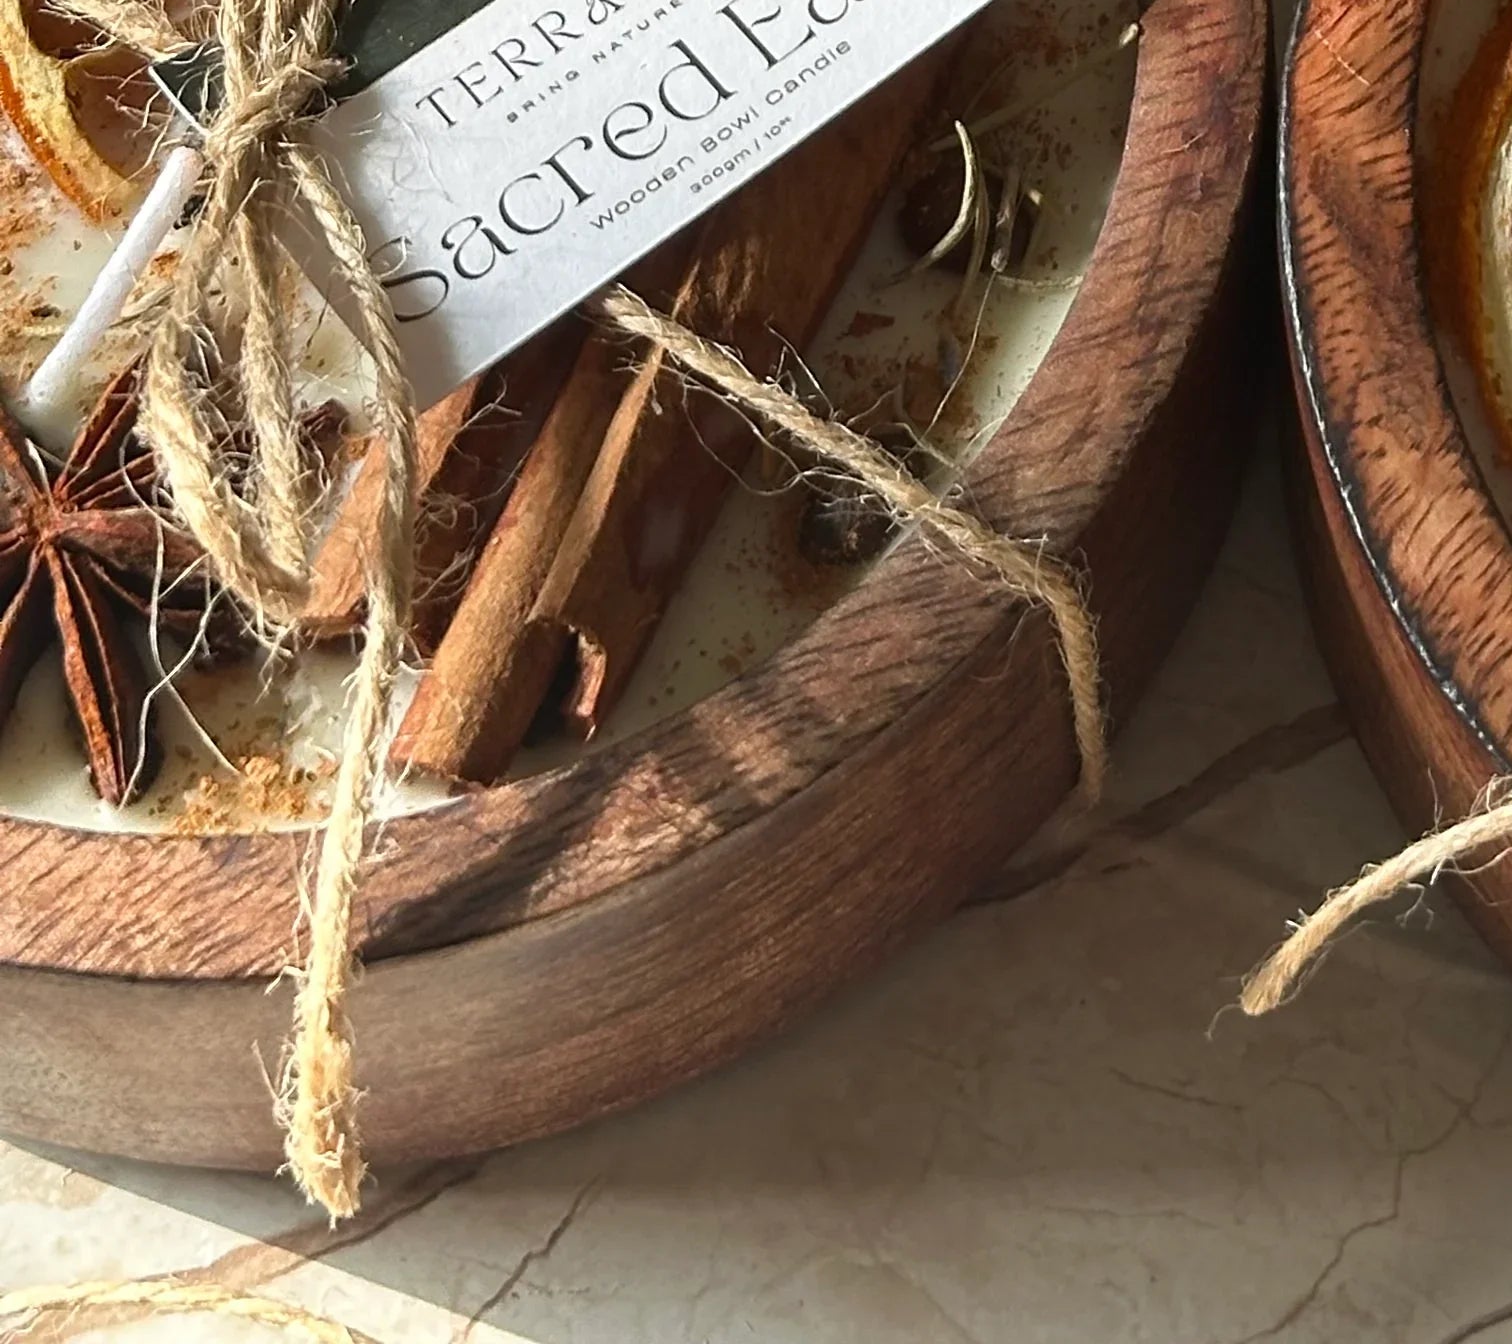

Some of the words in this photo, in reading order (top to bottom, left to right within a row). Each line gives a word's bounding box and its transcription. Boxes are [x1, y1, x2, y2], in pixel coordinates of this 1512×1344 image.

[367, 39, 739, 323] Sacred
[506, 69, 581, 124] BRING
[588, 155, 695, 231] Wooden
[699, 105, 760, 154] Bowl
[764, 39, 852, 106] Candle
